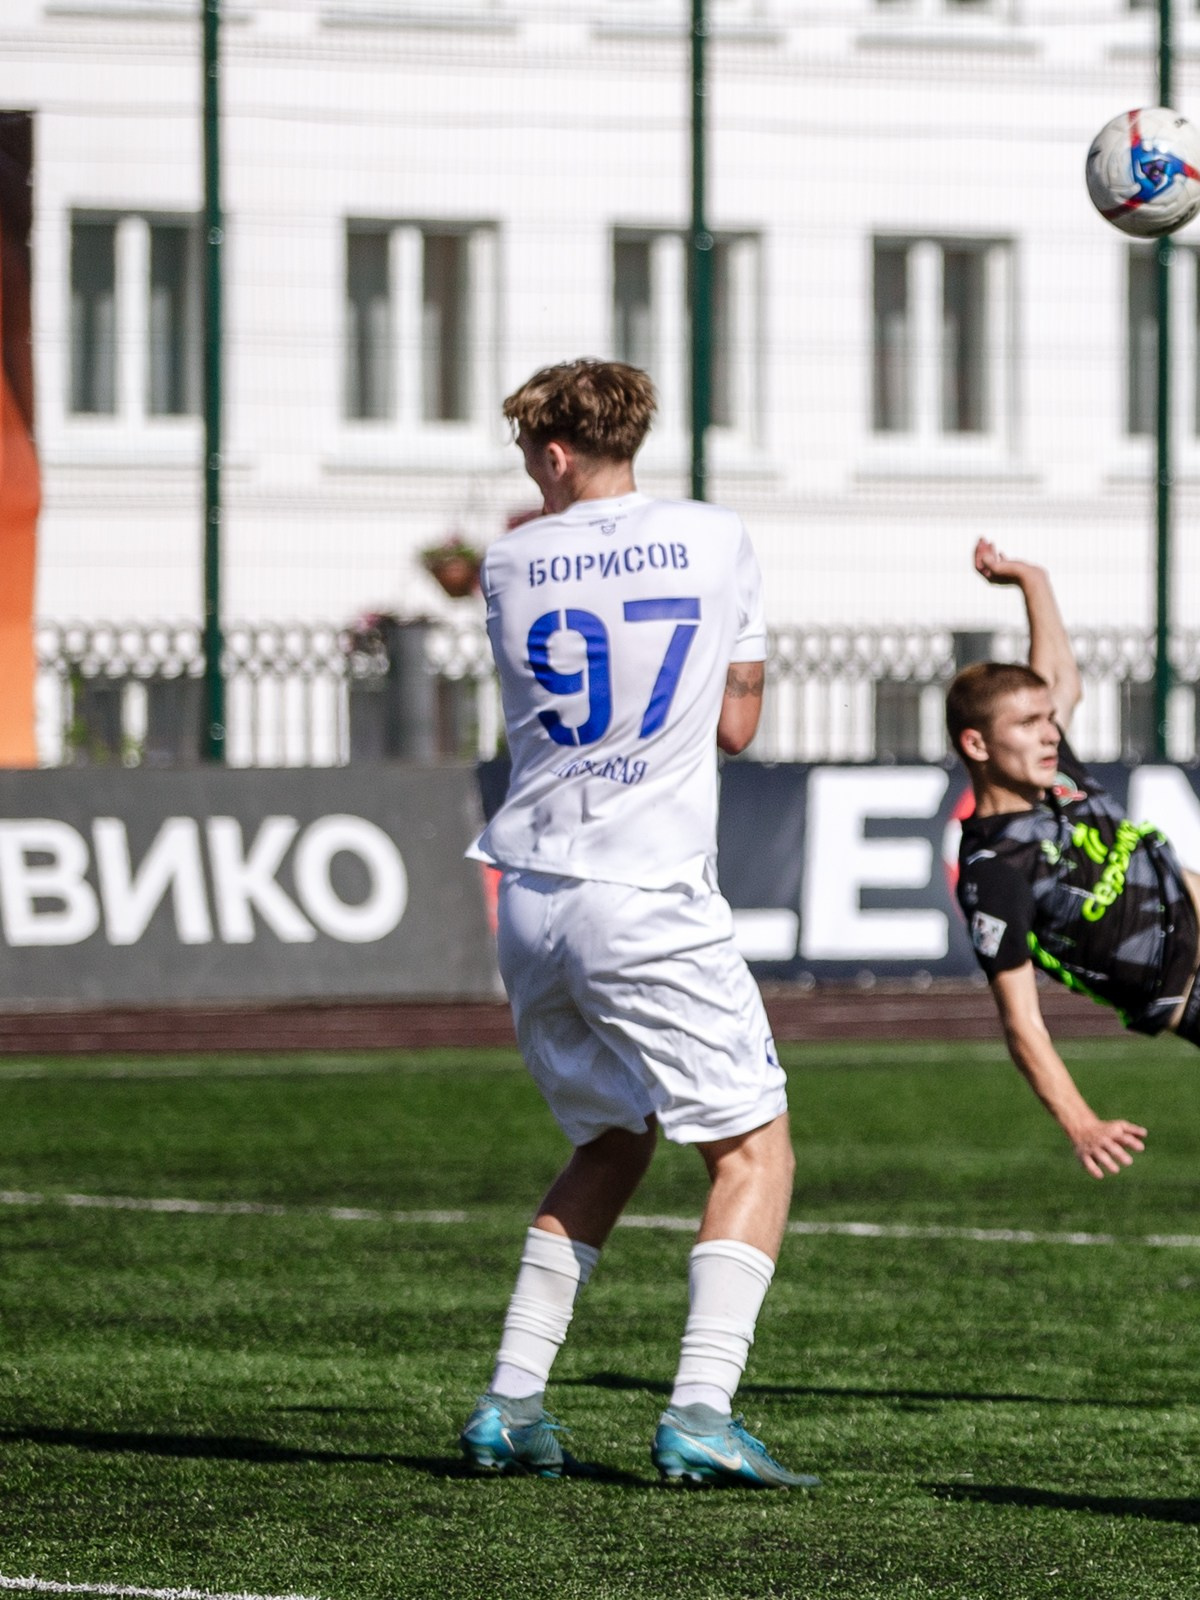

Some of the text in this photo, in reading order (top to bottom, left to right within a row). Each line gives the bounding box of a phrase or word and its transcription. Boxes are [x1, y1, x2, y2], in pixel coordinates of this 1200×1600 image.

[528, 542, 690, 588] БОРИСОВ
[527, 597, 701, 746] 97
[0, 812, 409, 947] ВИКО
